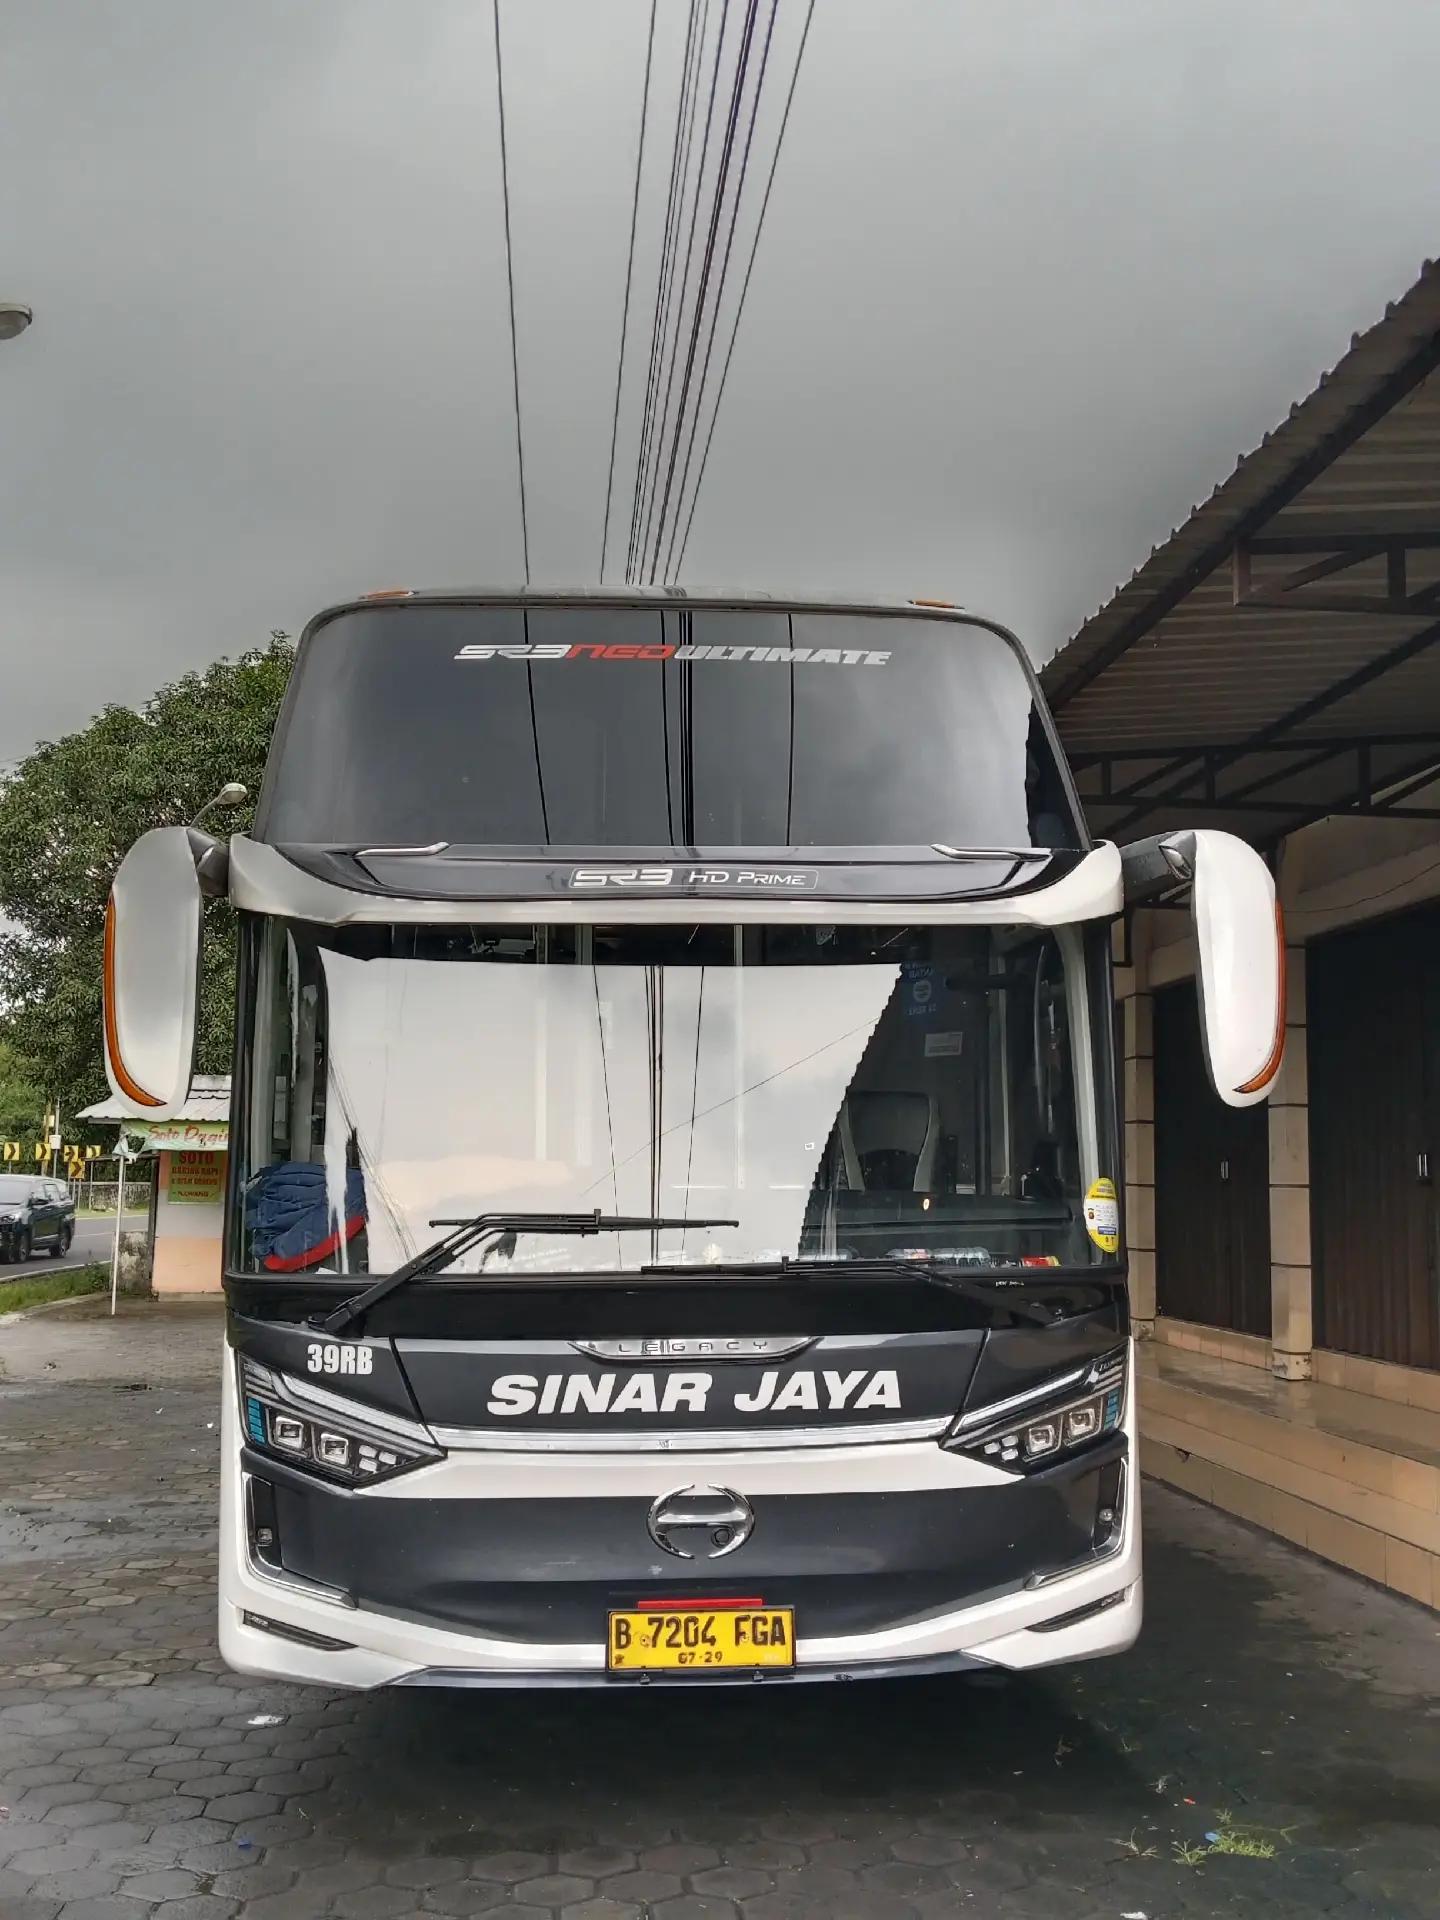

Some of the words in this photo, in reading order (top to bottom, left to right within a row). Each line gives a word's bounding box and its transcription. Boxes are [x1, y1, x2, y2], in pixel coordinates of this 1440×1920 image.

[674, 645, 892, 665] ULTIMATE
[573, 868, 673, 886] SR3
[688, 870, 730, 883] HD
[307, 1343, 373, 1375] 39RB
[618, 1340, 768, 1353] LEGACY
[486, 1372, 714, 1416] SINAR
[733, 1370, 902, 1412] JAYA
[615, 1618, 632, 1650] B
[647, 1615, 718, 1649] 7204
[734, 1614, 786, 1647] FGA
